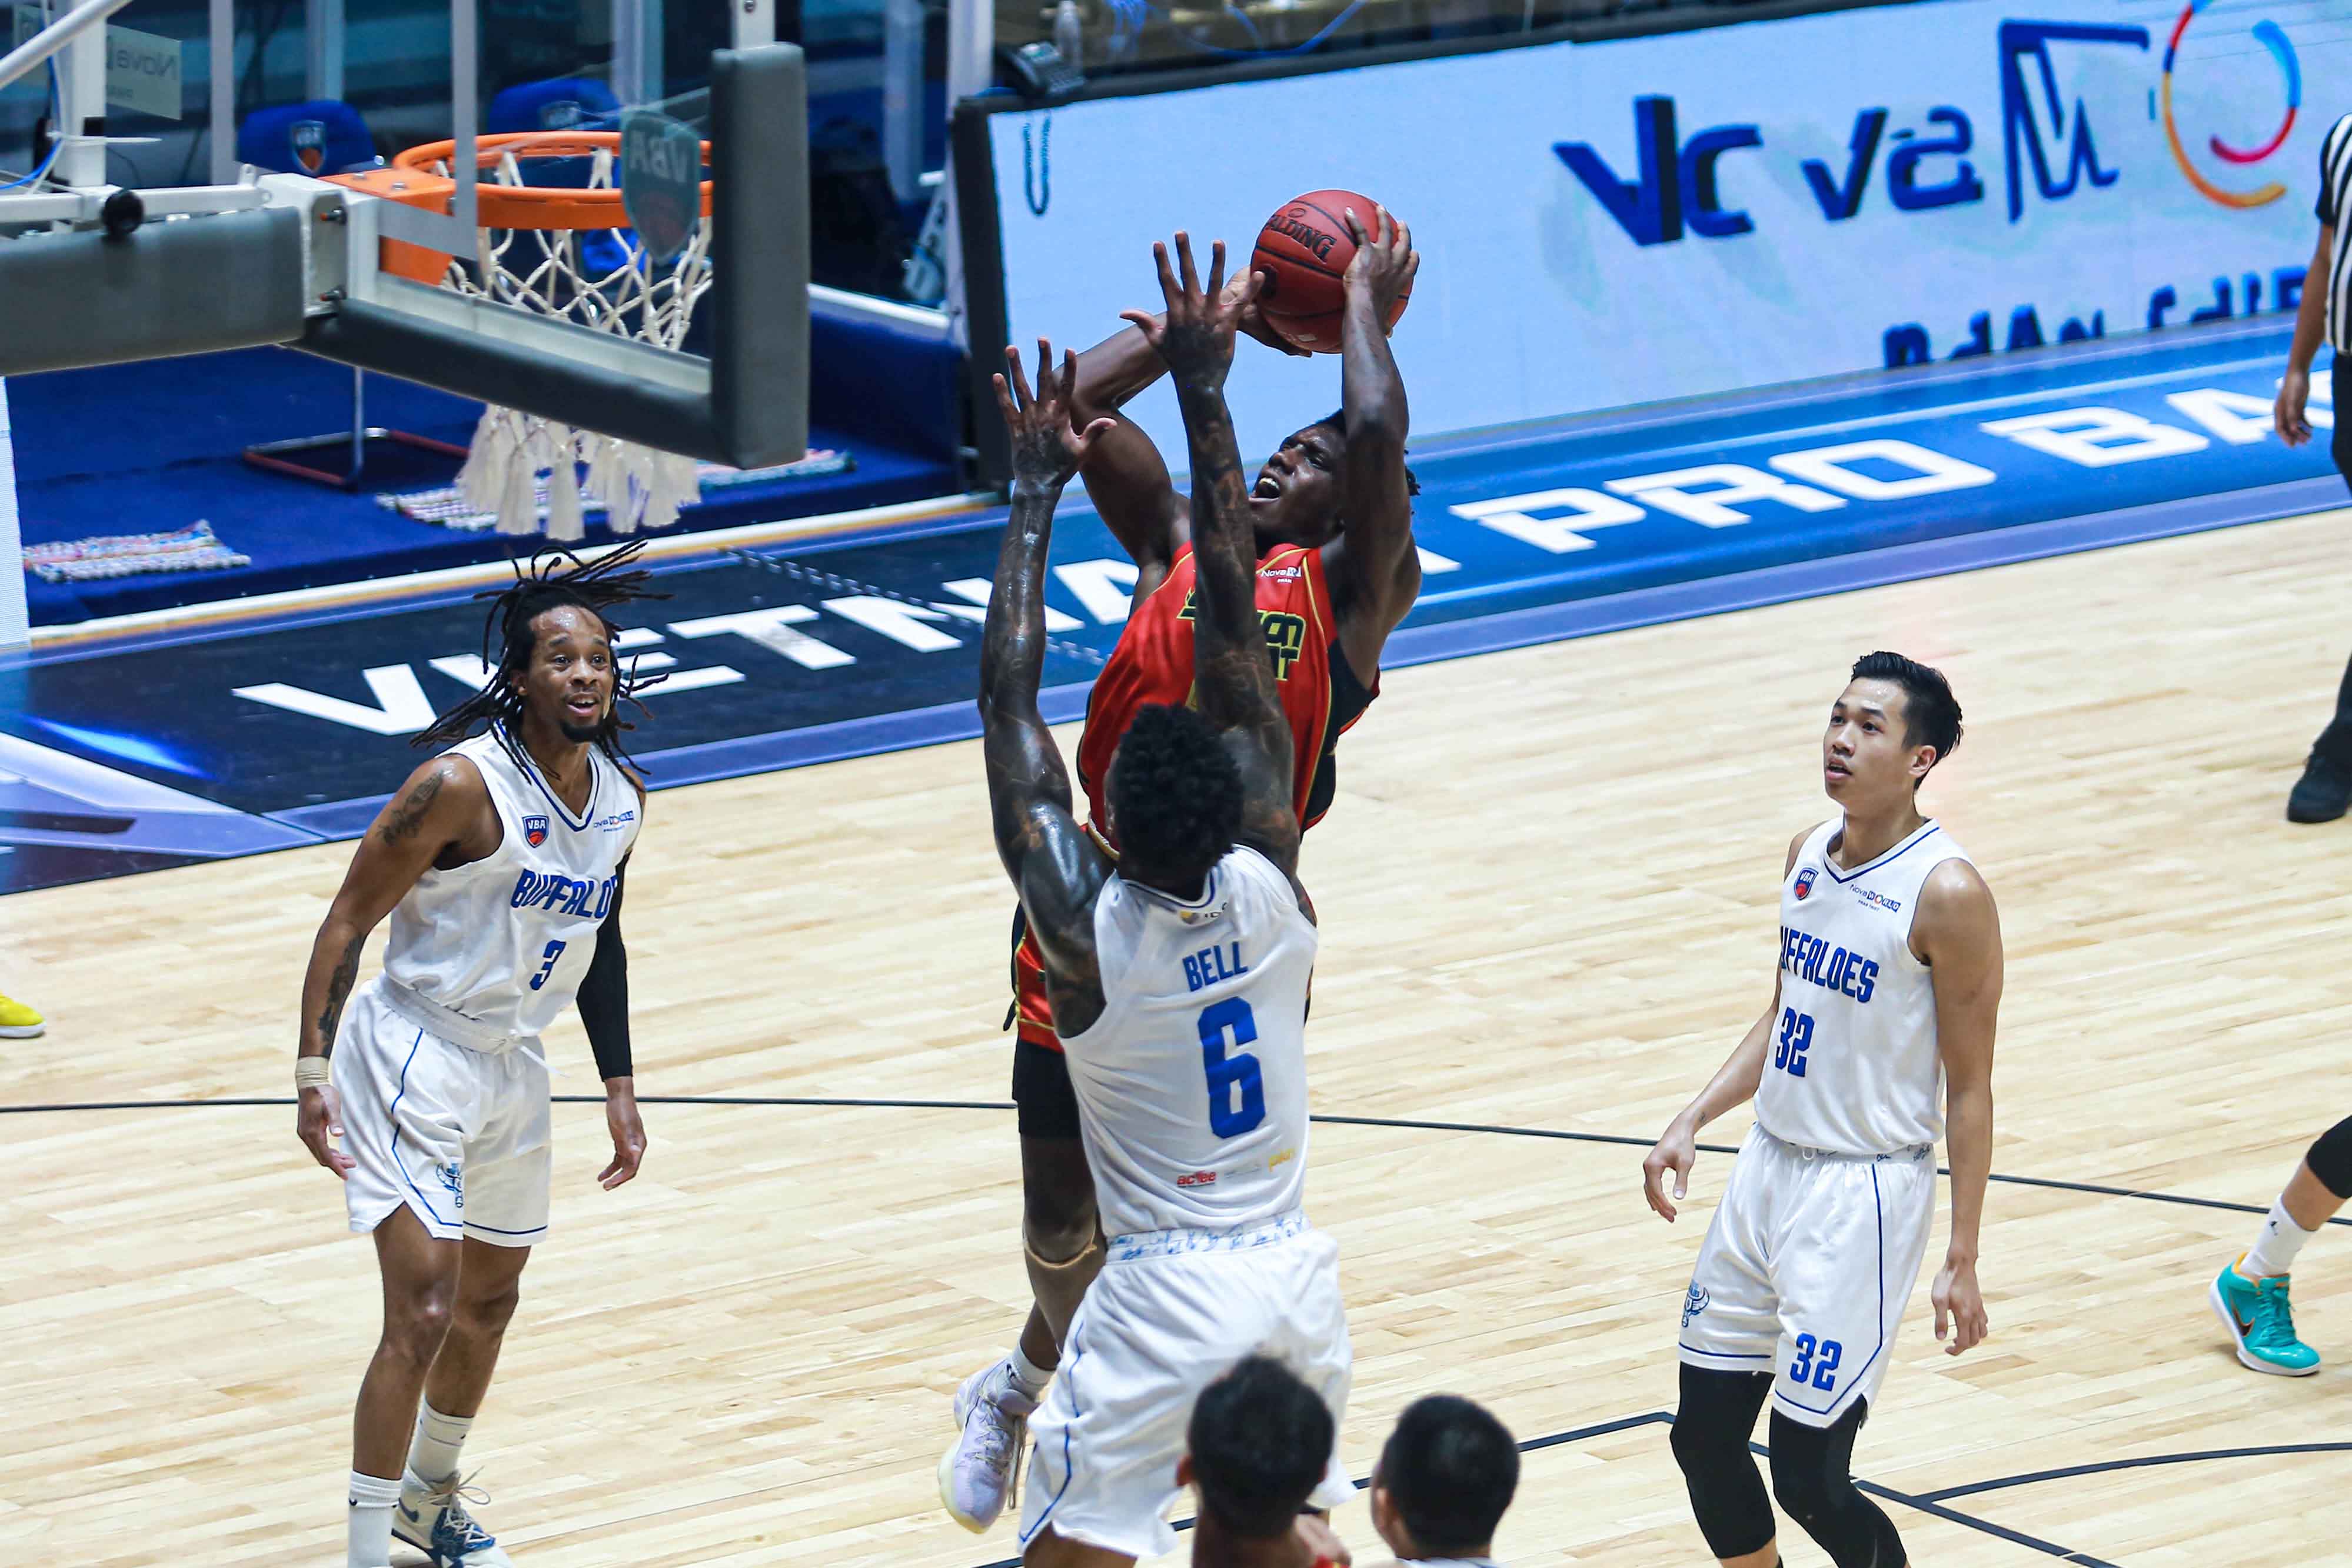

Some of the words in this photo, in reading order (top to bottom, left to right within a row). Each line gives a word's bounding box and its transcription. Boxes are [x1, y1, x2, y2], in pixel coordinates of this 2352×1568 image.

[1449, 438, 1997, 555] PRO
[528, 819, 546, 830] VBA
[510, 868, 618, 919] BUFFALO
[1799, 871, 1815, 883] VBA
[529, 939, 567, 991] 3
[1183, 941, 1249, 992] BELL
[1780, 926, 1879, 1003] UFFALOES
[1197, 996, 1266, 1138] 6
[1775, 1007, 1815, 1078] 32
[1789, 1332, 1842, 1393] 32
